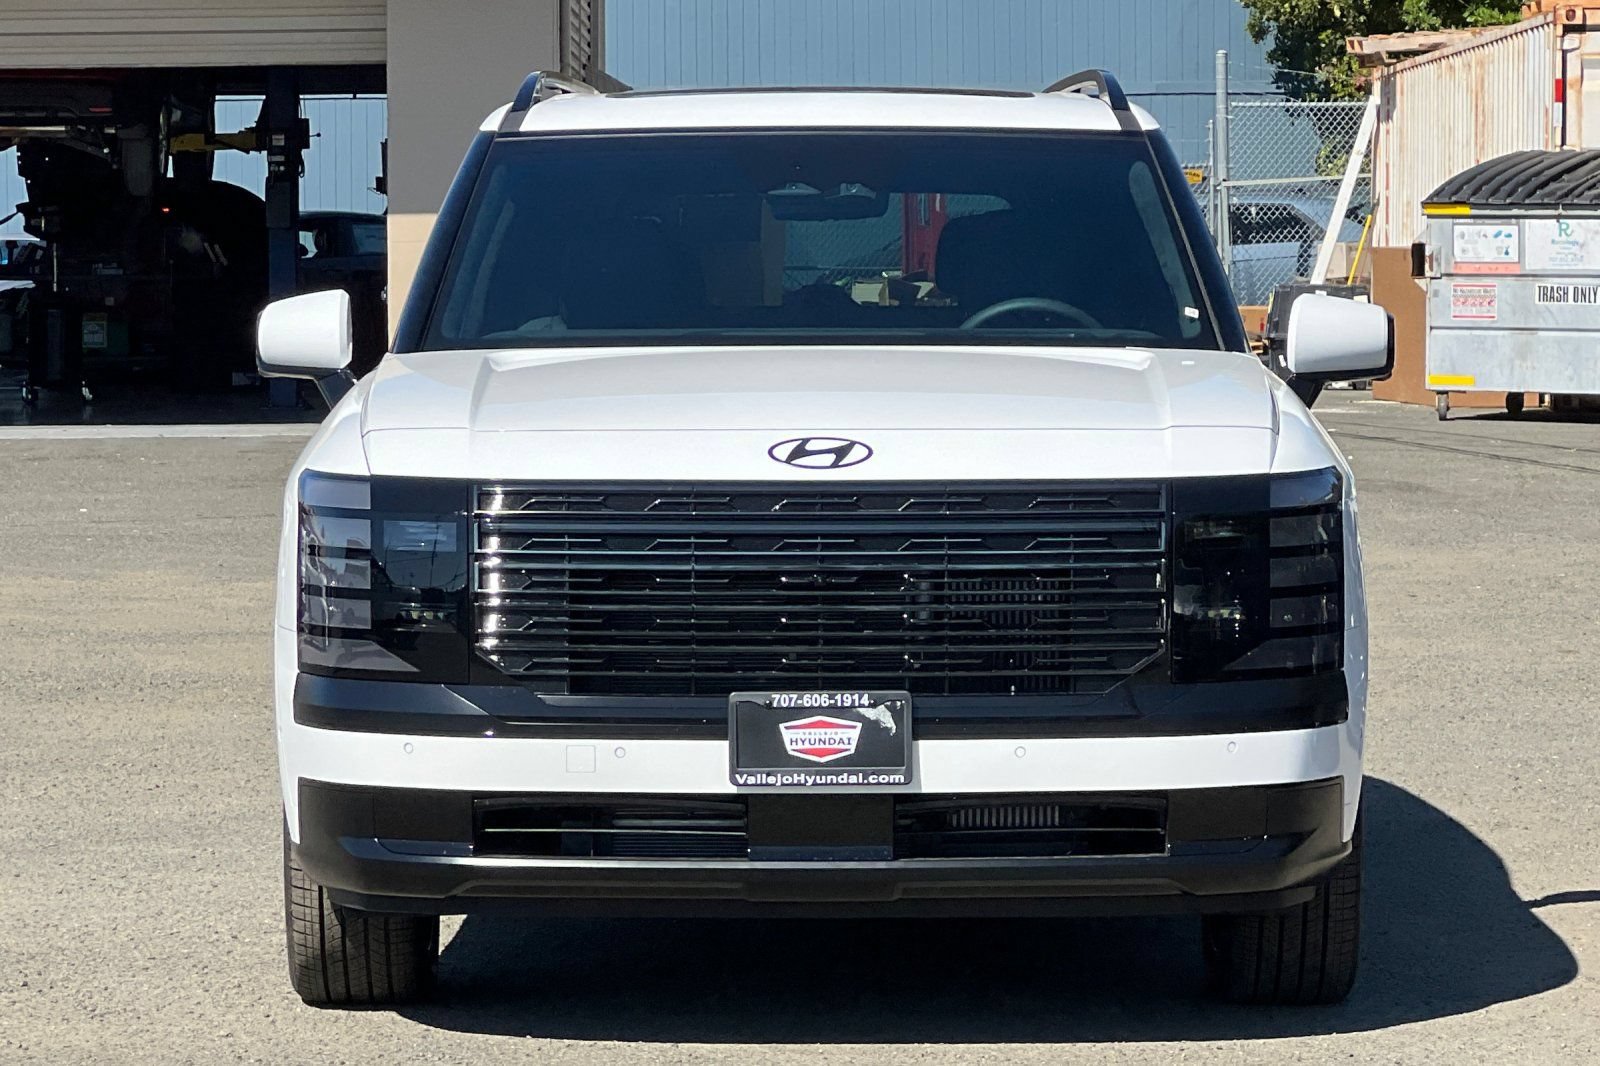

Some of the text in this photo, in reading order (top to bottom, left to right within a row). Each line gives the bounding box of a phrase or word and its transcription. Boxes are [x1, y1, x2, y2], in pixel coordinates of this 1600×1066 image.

[1537, 285, 1599, 304] TRASH ONLY
[771, 693, 870, 707] 707-606-1914
[789, 737, 852, 746] HYUNDAI
[735, 773, 905, 786] VallejoHyundai.com
